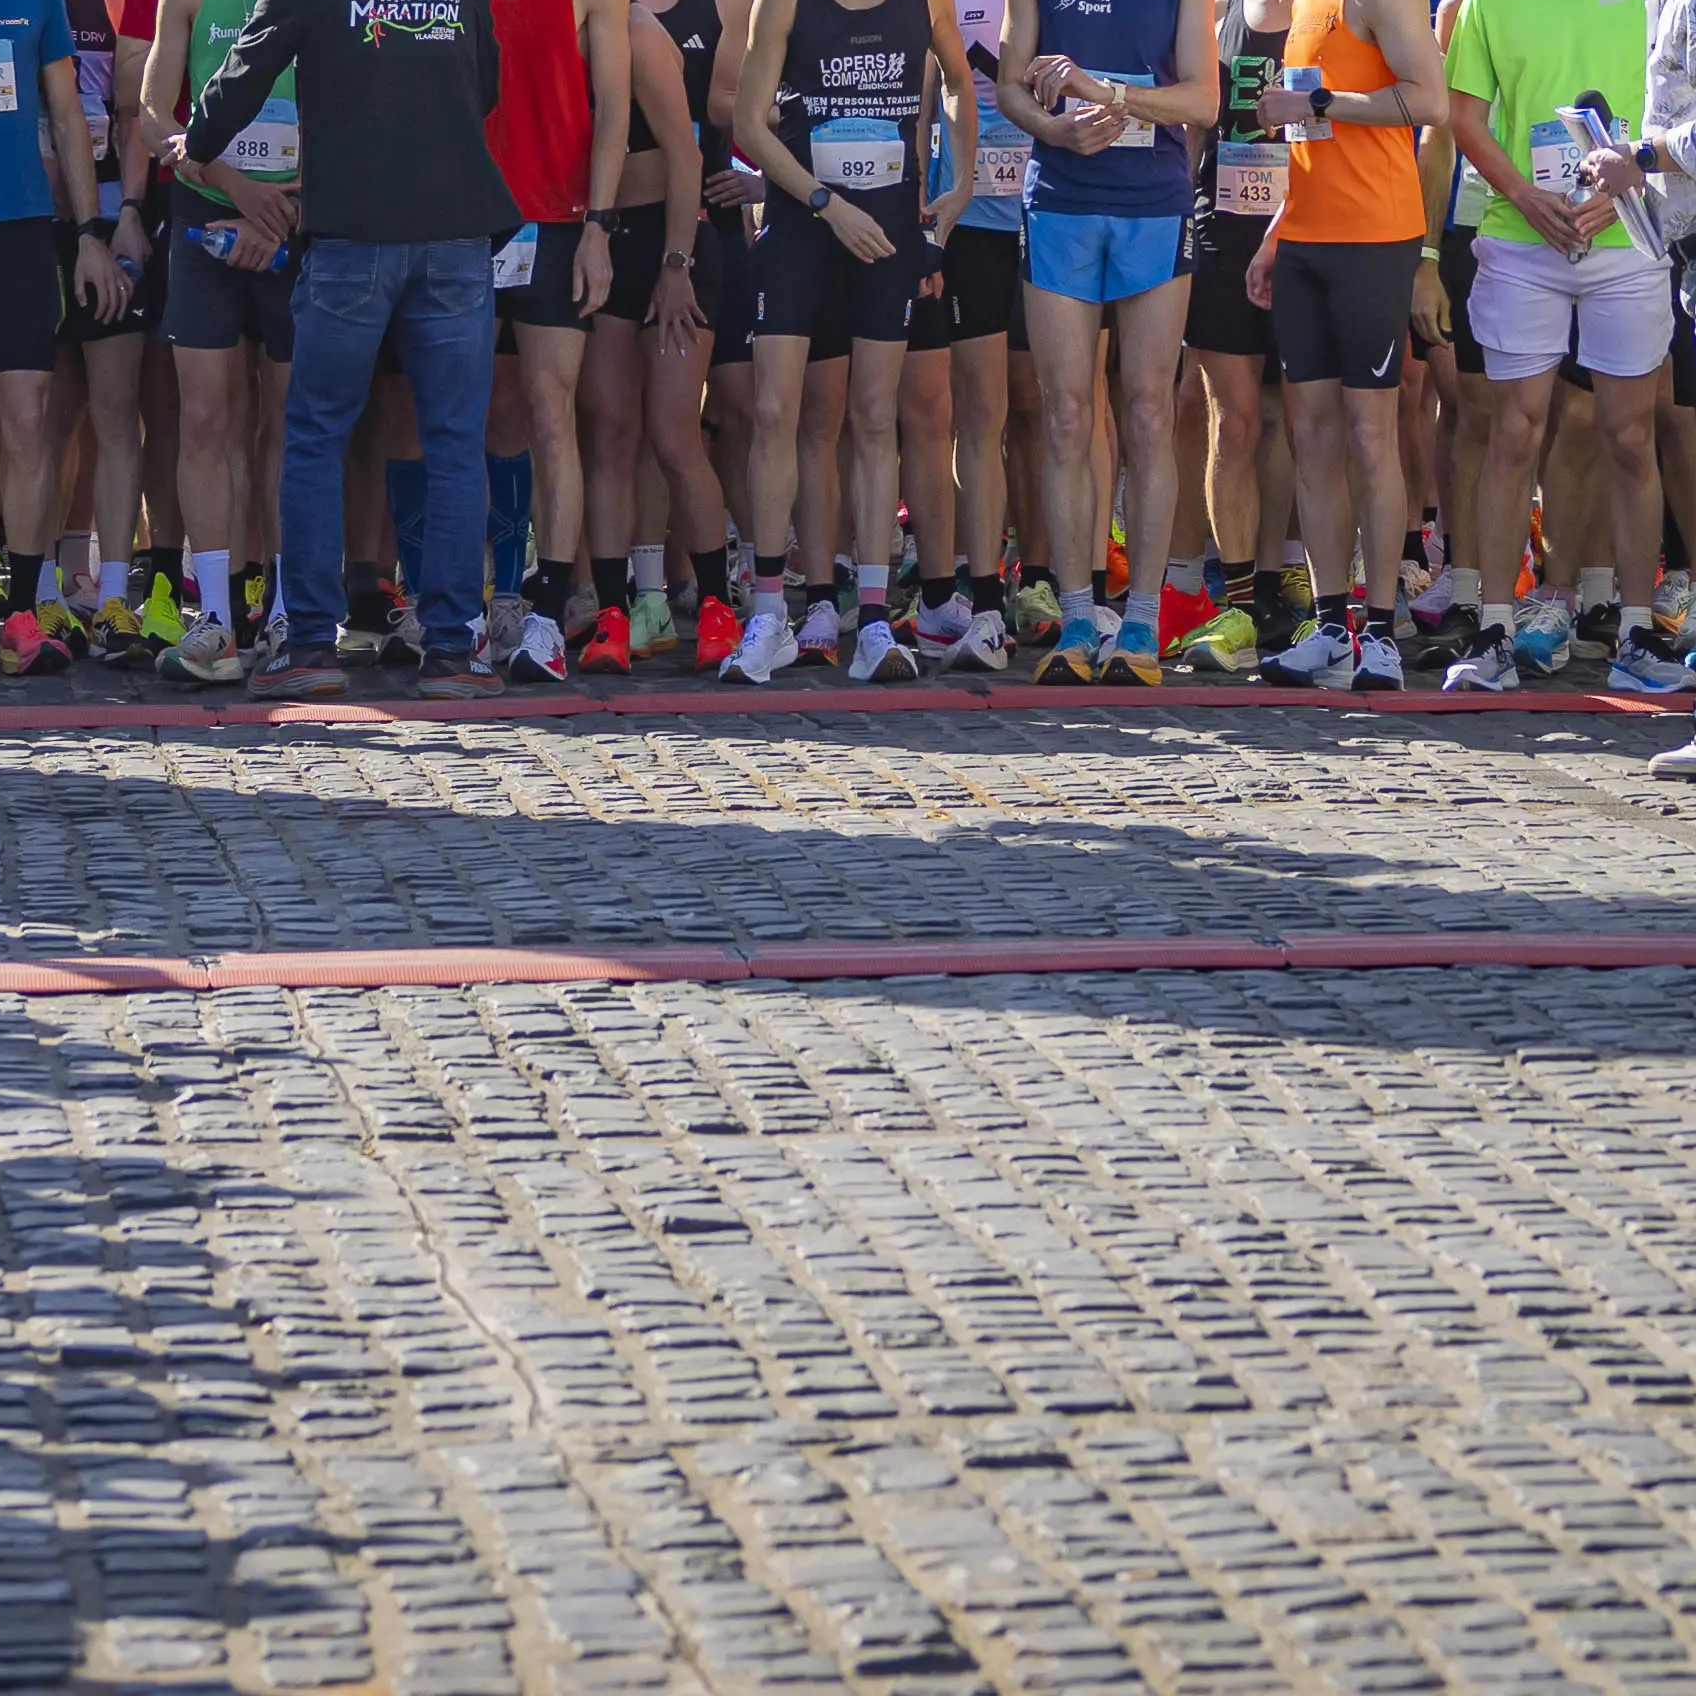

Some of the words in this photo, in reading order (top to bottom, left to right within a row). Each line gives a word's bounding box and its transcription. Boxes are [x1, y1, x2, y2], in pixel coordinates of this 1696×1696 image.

[350, 0, 460, 28] MARATHON
[820, 54, 887, 74] LOPERS
[822, 69, 888, 87] COMPANY
[857, 81, 904, 91] EINDHOVEN
[831, 96, 885, 106] PERSONAL
[236, 141, 270, 158] 888
[1557, 147, 1581, 161] TO
[842, 161, 875, 177] 892
[994, 167, 1017, 182] 44
[1561, 161, 1581, 179] 24
[1238, 170, 1273, 185] TOM
[1239, 186, 1271, 202] 433
[1183, 218, 1195, 260] NIKE
[265, 654, 291, 674] HOKA
